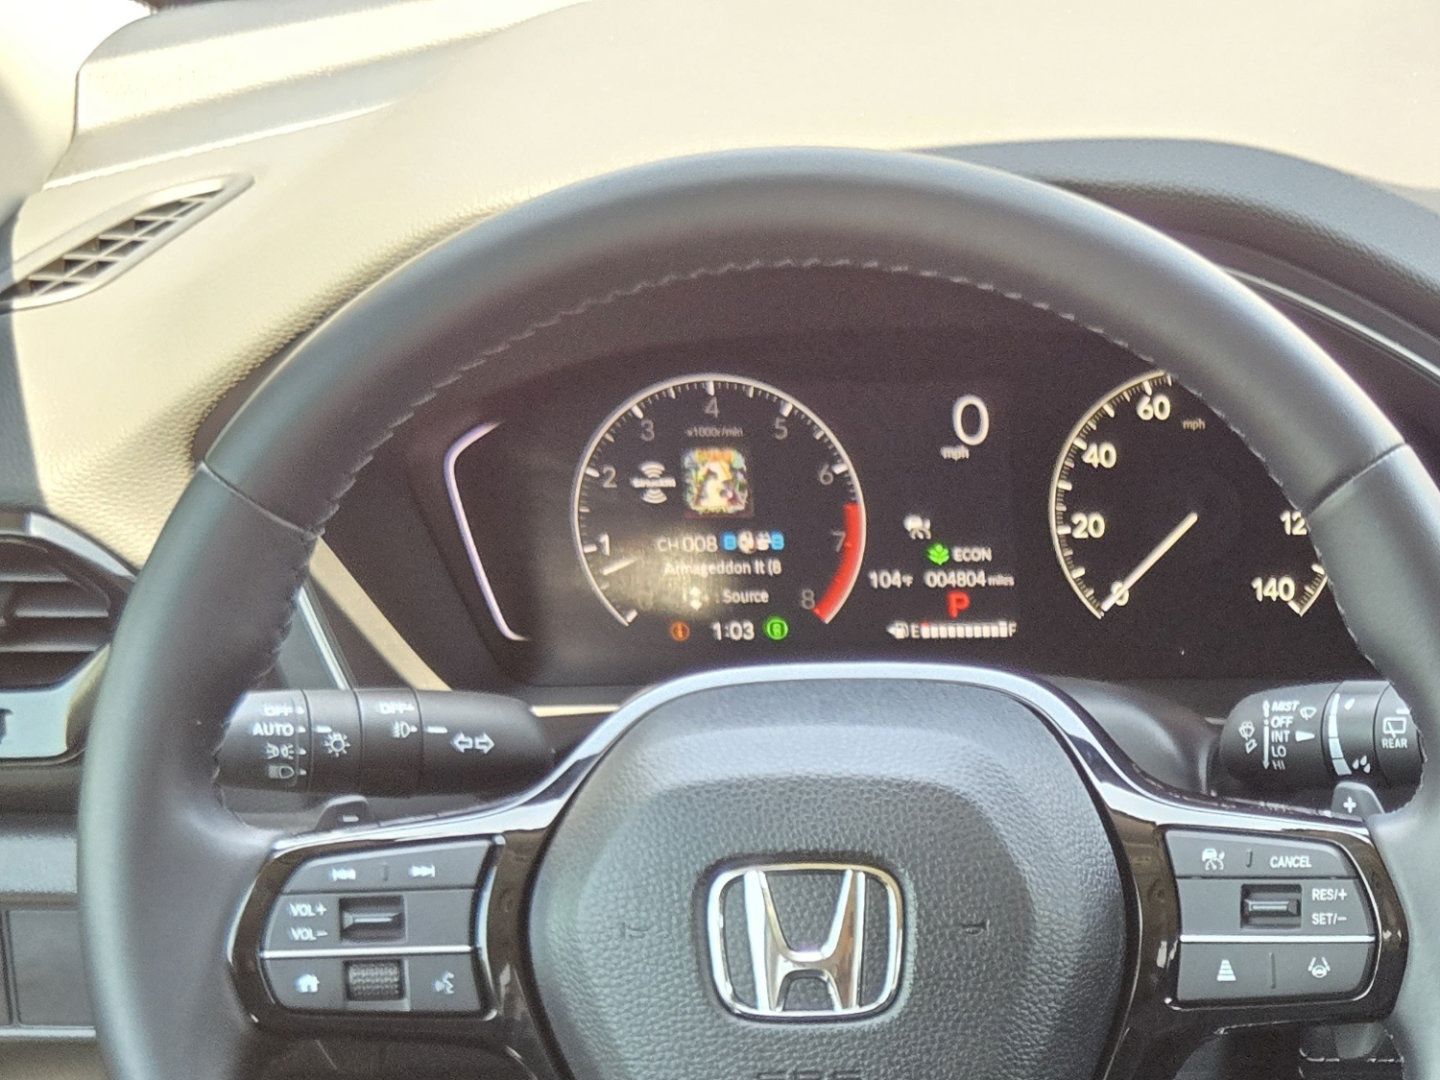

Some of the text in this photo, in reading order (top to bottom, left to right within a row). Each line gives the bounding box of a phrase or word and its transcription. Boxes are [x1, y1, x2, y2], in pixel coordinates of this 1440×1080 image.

[704, 397, 719, 418] 4
[1136, 395, 1171, 420] 60
[774, 418, 788, 440] 5
[952, 394, 990, 446] 0
[1183, 417, 1205, 432] mph
[640, 420, 655, 441] 3
[940, 446, 969, 461] mph
[1081, 443, 1117, 469] 40
[602, 466, 617, 488] 2
[818, 464, 834, 485] 6
[1072, 513, 1105, 538] 20
[1280, 511, 1308, 535] 12
[599, 534, 610, 556] 1
[657, 534, 718, 552] CH 008
[832, 531, 847, 552] 7
[952, 546, 992, 562] ECON
[924, 571, 986, 588] 004804
[722, 589, 769, 603] Source
[1251, 578, 1296, 602] 140
[801, 589, 815, 610] 8
[946, 590, 970, 618] P
[711, 621, 755, 640] 1:03
[911, 622, 919, 638] E
[1271, 700, 1299, 712] MIST
[252, 723, 295, 737] AUTO
[1271, 716, 1293, 728] OFF
[1271, 730, 1290, 741] INT
[1382, 738, 1407, 748] REAR
[1271, 746, 1286, 758] LO
[1272, 760, 1285, 770] HI
[1270, 856, 1312, 868] CANCEL
[1312, 888, 1347, 901] RES/+
